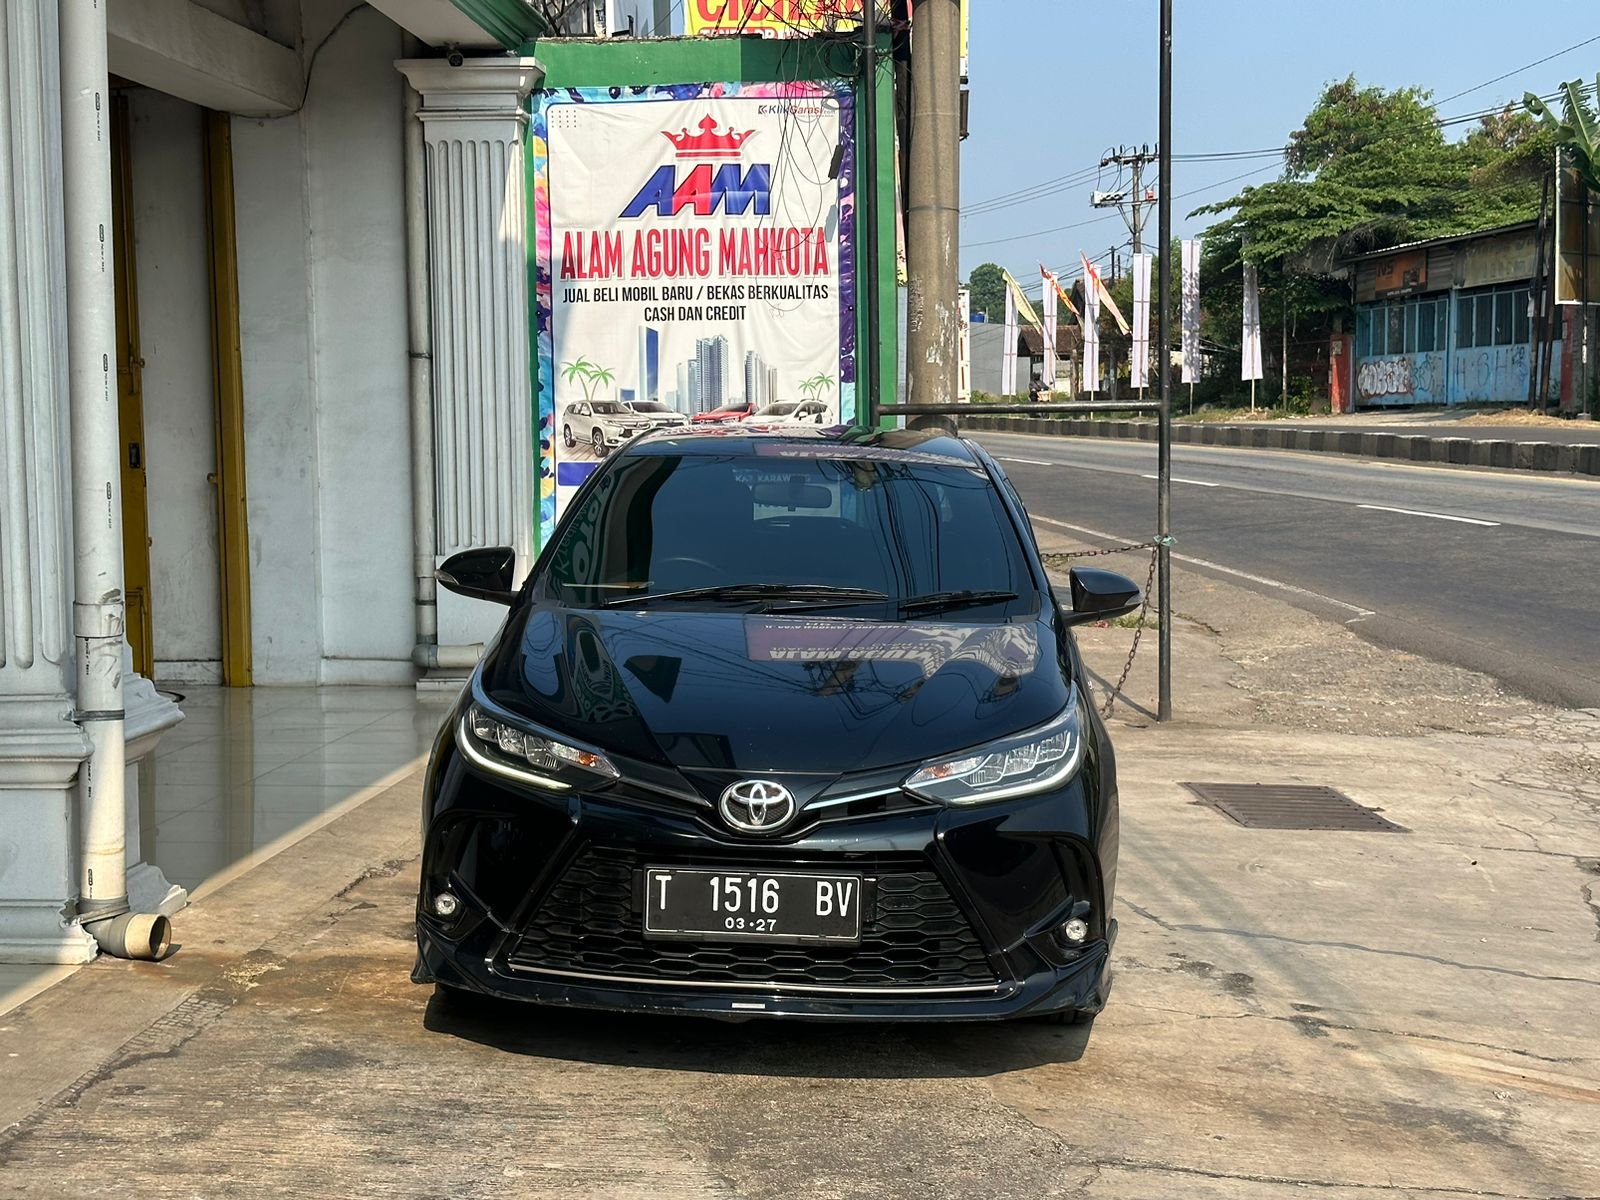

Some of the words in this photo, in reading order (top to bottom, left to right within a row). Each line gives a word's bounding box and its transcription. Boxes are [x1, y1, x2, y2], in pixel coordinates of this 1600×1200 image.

[619, 163, 771, 217] AAM
[560, 230, 623, 279] ALAM
[631, 228, 710, 278] AGUNG
[719, 227, 829, 276] MAHKOTA
[562, 288, 590, 303] JUAL
[594, 287, 619, 301] BELI
[622, 286, 659, 301] MOBIL
[662, 286, 693, 300] BARU
[696, 286, 704, 300] /
[707, 286, 745, 300] BEKAS
[748, 284, 829, 300] BERKUALITAS
[644, 307, 675, 321] CASH
[678, 306, 702, 320] DAN
[706, 305, 747, 320] CREDIT
[655, 875, 672, 910] T
[709, 876, 780, 913] 1516
[815, 881, 852, 917] BV
